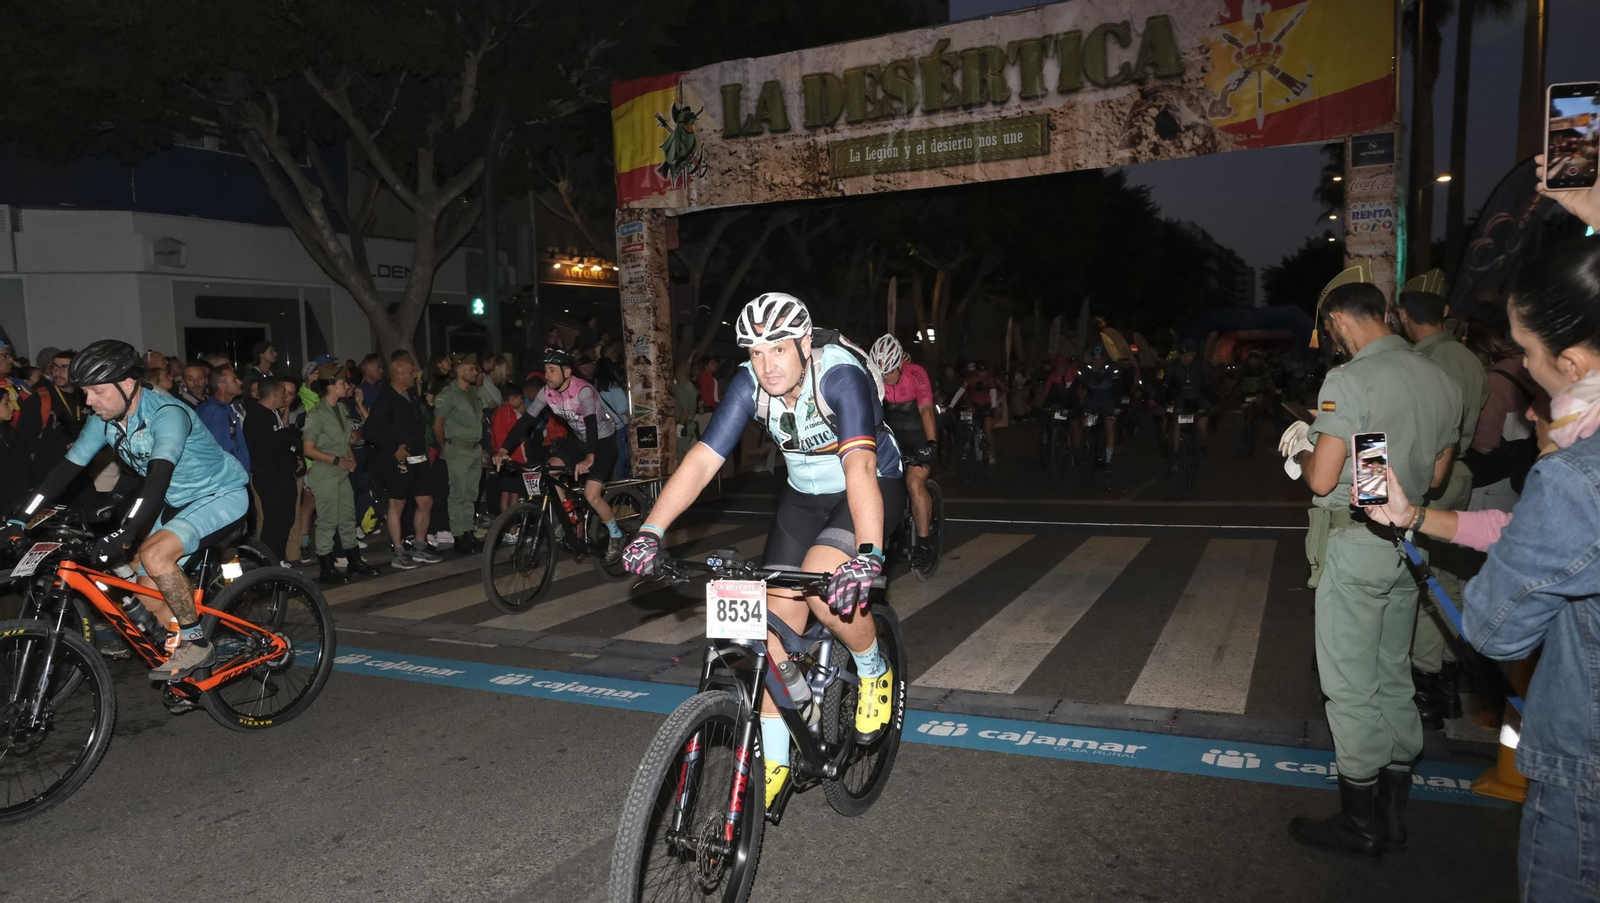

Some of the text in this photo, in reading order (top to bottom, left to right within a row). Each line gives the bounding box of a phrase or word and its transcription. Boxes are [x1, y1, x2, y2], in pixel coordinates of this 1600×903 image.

[720, 14, 1186, 138] LA DESÉRTICA
[849, 131, 1024, 163] La Legión y el desierto nos une
[1352, 201, 1392, 210] GRUPO
[1352, 208, 1393, 221] RENTA
[103, 528, 126, 543] FOX
[717, 599, 762, 622] 8534
[364, 660, 466, 676] cajamar
[532, 680, 651, 699] cajamar
[896, 680, 905, 730] MAXXIS
[239, 718, 273, 726] MAXXIS
[977, 729, 1148, 754] cajamar
[1054, 746, 1138, 759] CAJA RURAL
